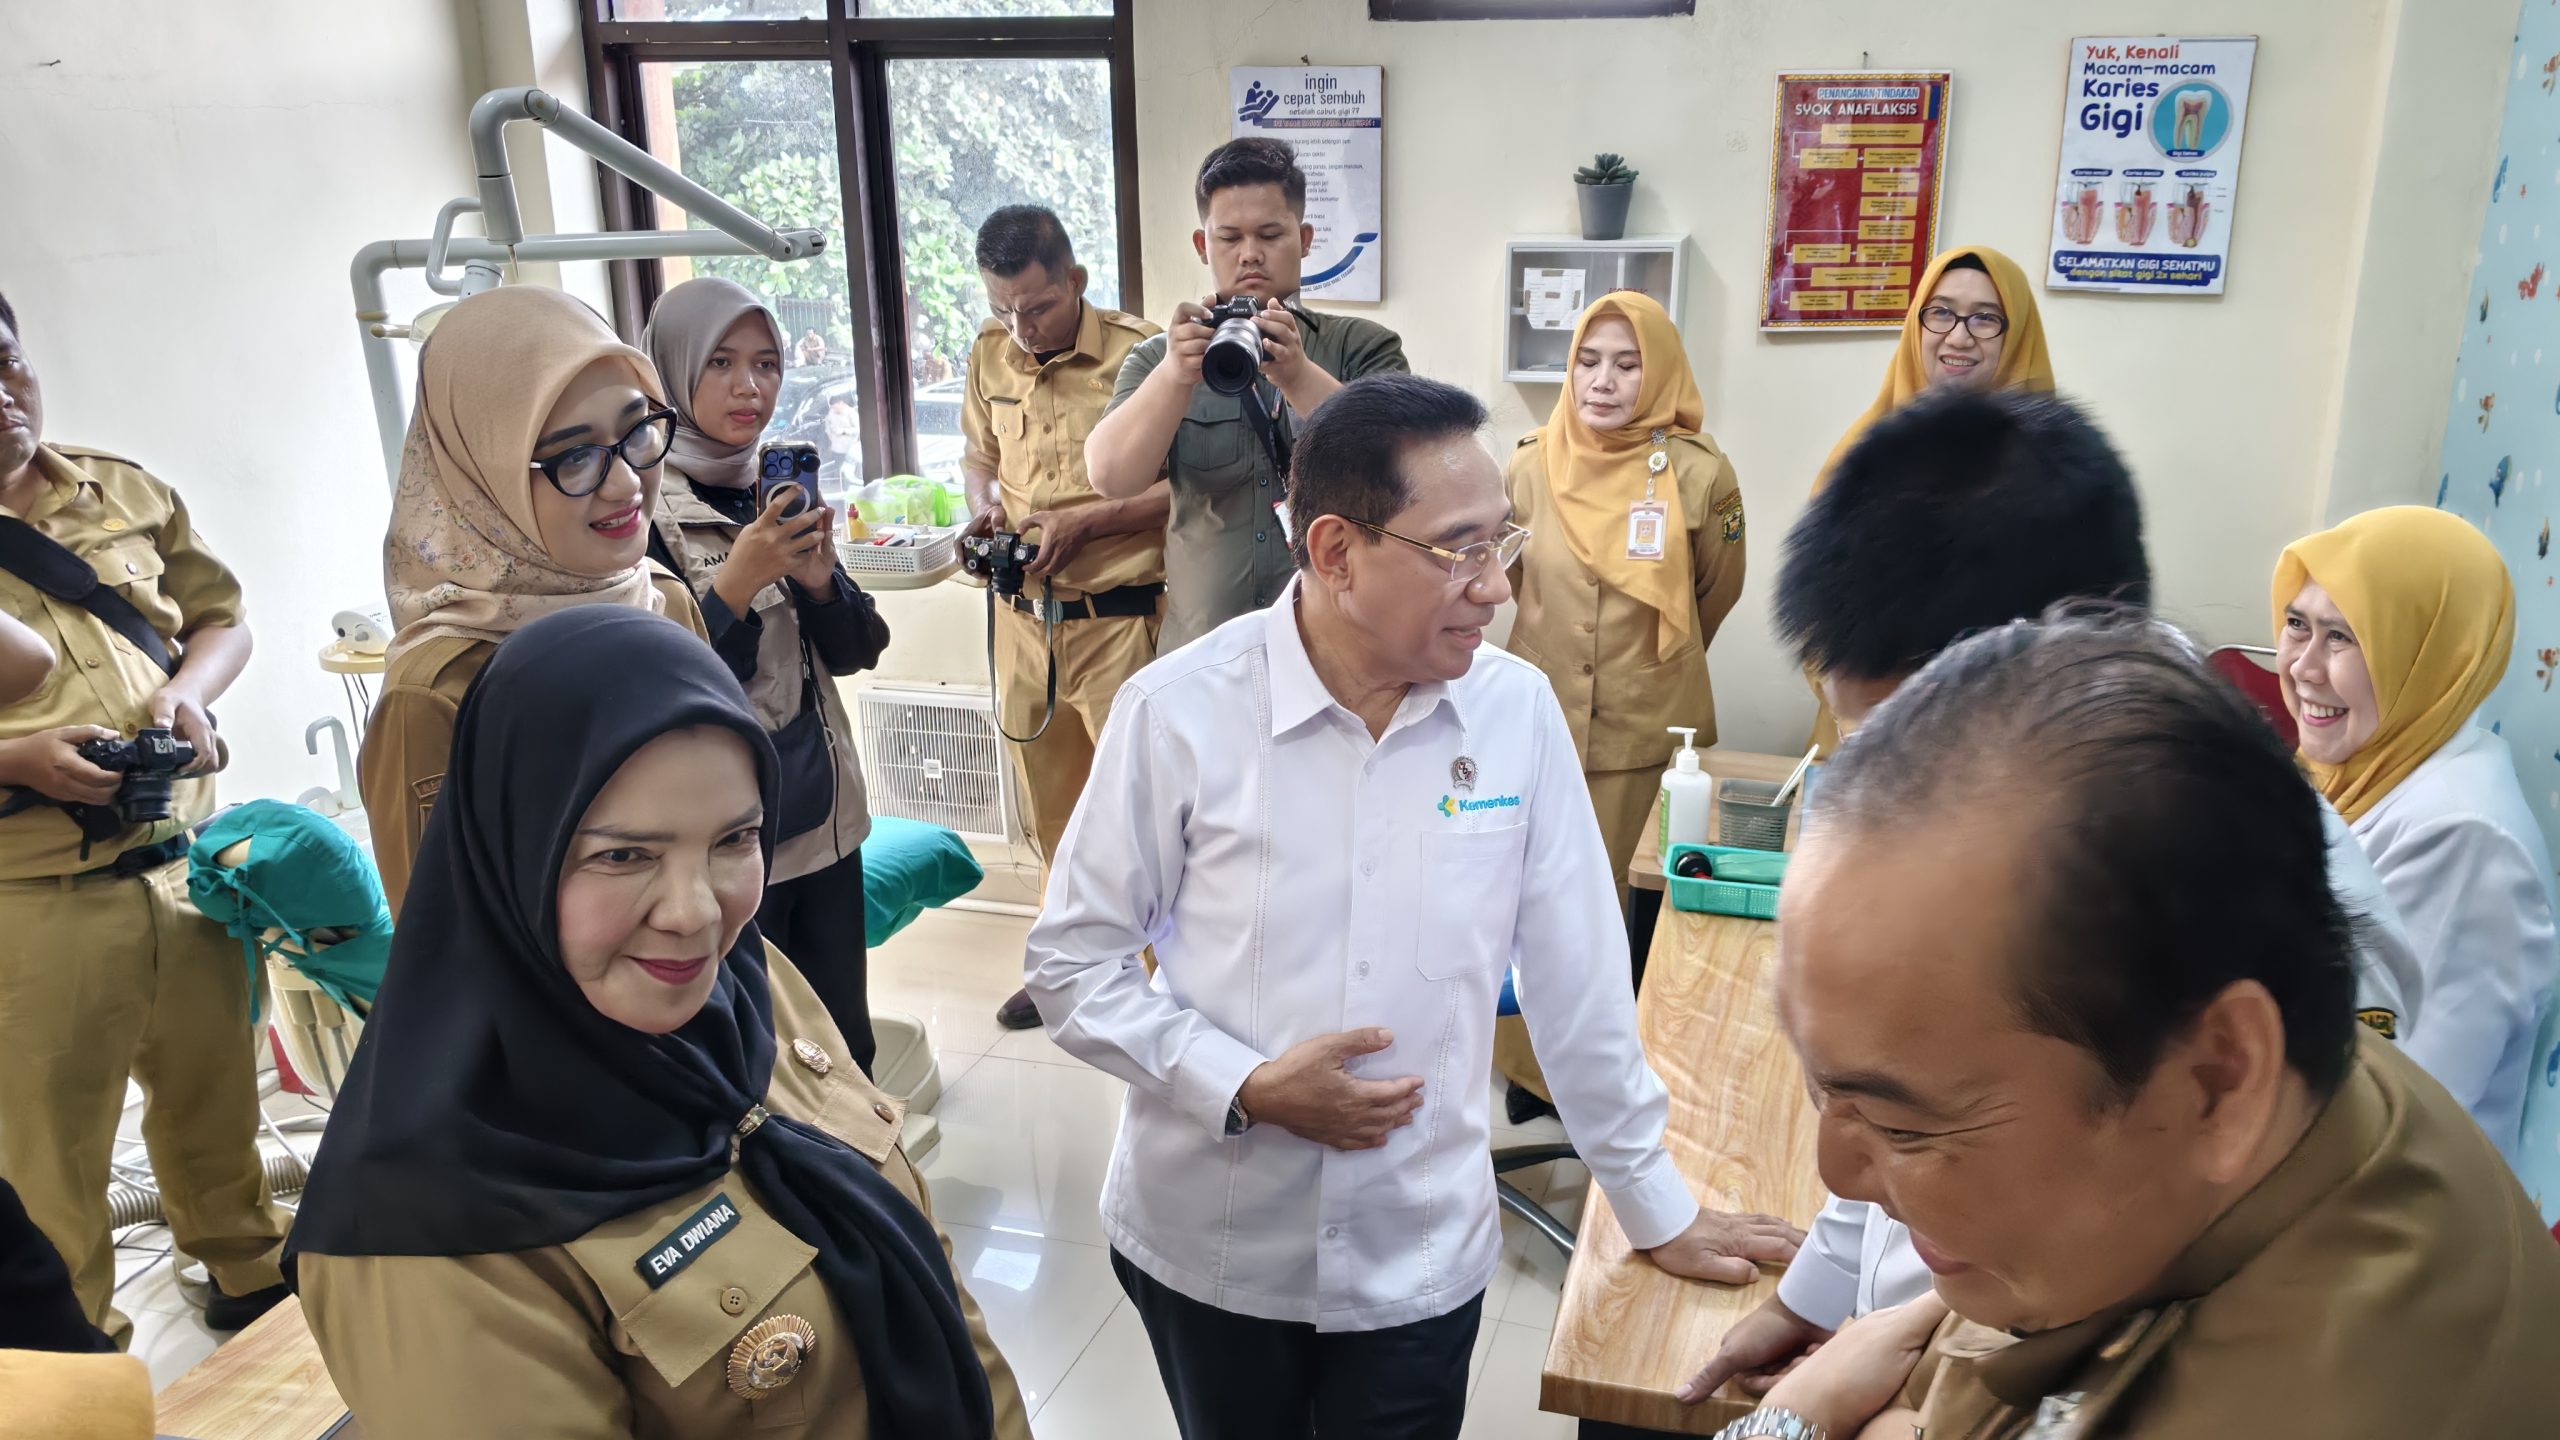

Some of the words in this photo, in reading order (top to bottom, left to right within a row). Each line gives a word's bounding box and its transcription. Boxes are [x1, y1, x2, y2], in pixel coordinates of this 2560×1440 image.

[2086, 45, 2120, 61] Yuk,
[2125, 44, 2180, 59] Kenali
[2083, 62, 2216, 75] Macam-macam
[1305, 73, 1337, 93] ingin
[2083, 78, 2160, 97] Karies
[1283, 92, 1316, 107] cepat
[1320, 92, 1365, 104] sembuh
[1818, 88, 1874, 98] PENANGANAN
[1877, 88, 1918, 98] TINDAKAN
[1289, 107, 1315, 115] setelah
[1316, 107, 1336, 115] cabut
[1337, 108, 1350, 116] gigi
[1795, 104, 1832, 115] SYOK
[1838, 103, 1917, 115] ANAFILAKSIS
[2080, 102, 2144, 138] Gigi
[2058, 256, 2135, 269] SELAMATKAN
[2137, 259, 2160, 269] GIGI
[2161, 259, 2215, 271] SEHATMU
[2070, 269, 2107, 279] dengan
[2108, 269, 2133, 278] sikat
[2136, 270, 2154, 280] gigi
[2155, 271, 2168, 279] 2x
[2170, 270, 2202, 280] sehari
[1459, 795, 1521, 811] Kemenkes
[650, 1245, 683, 1276] EVA
[678, 1204, 736, 1252] DWIANA
